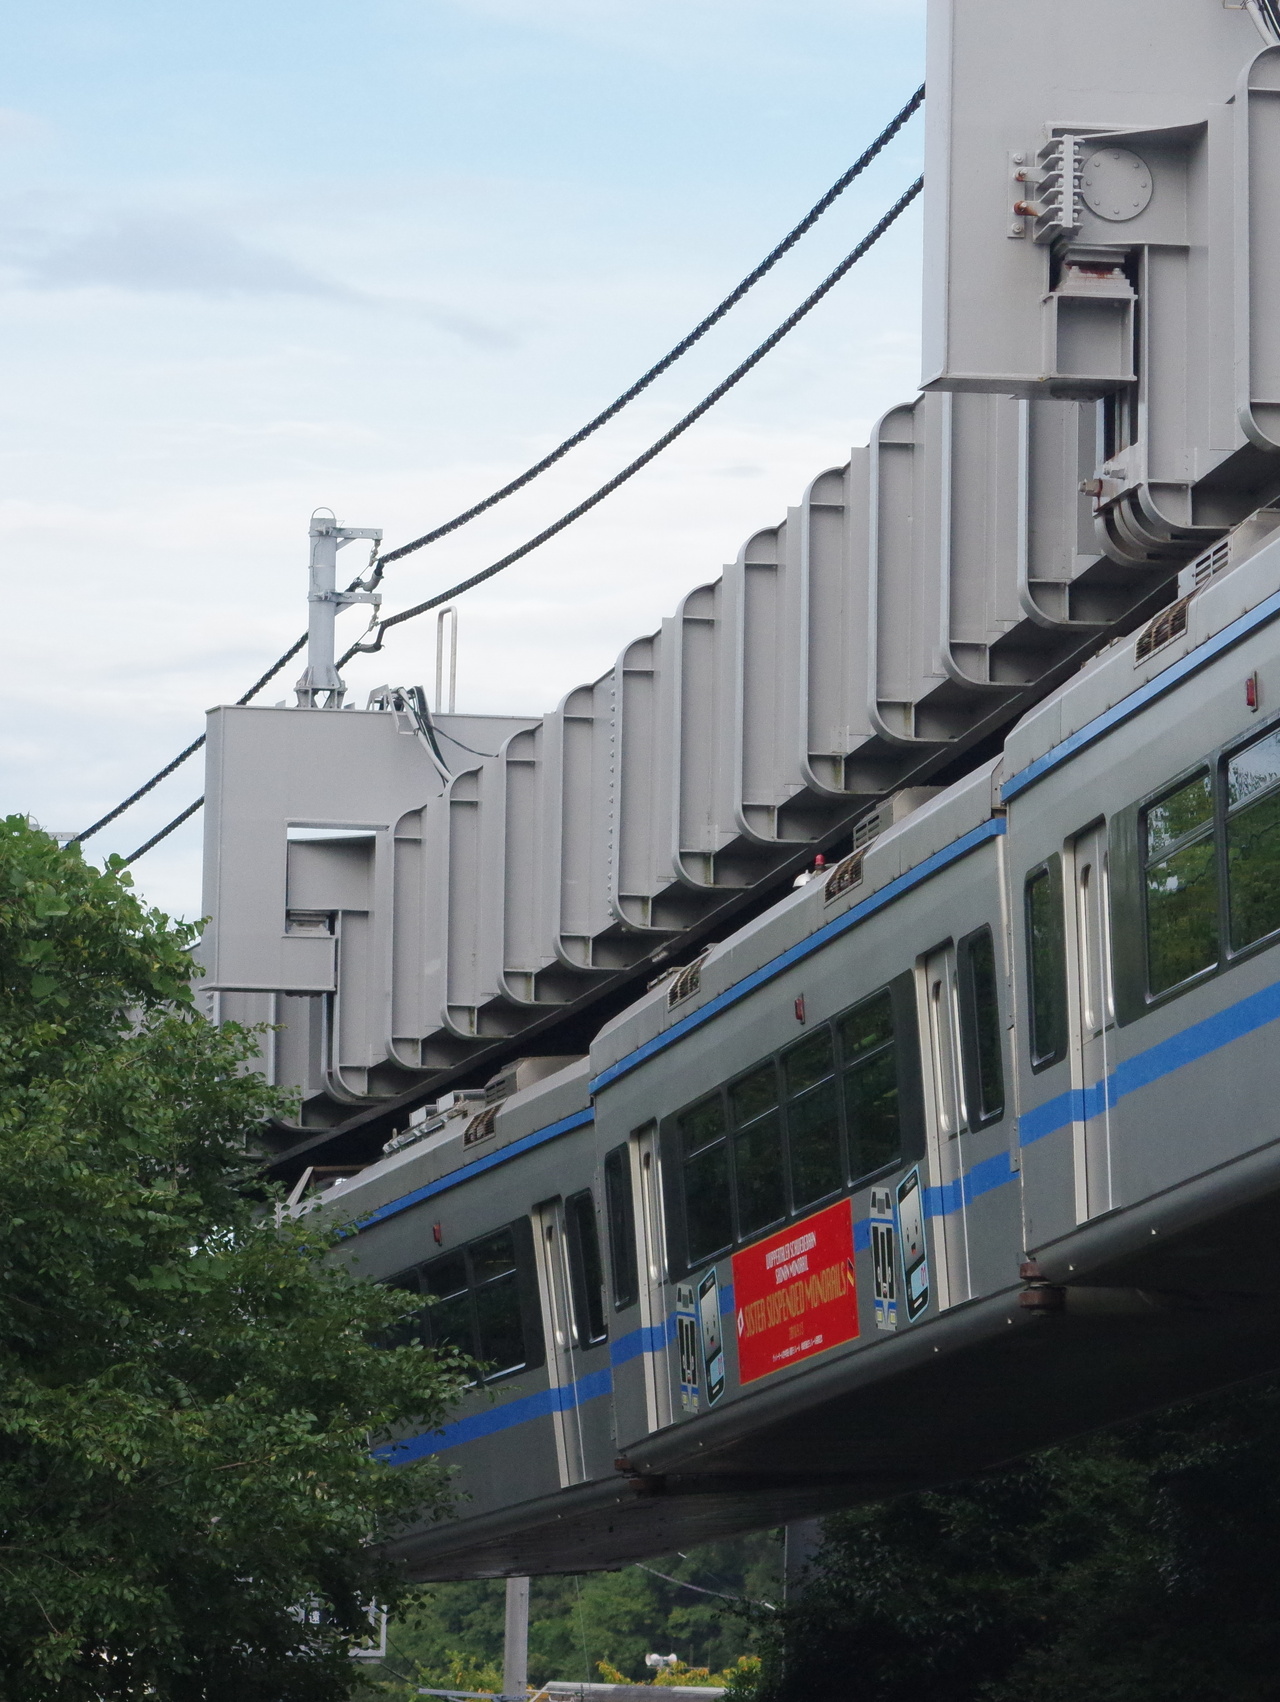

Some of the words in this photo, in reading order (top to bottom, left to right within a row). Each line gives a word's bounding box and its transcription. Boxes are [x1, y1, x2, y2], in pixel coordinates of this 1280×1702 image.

[744, 1298, 766, 1338] SISTER
[766, 1280, 805, 1328] SUSPENDED
[805, 1261, 847, 1311] MONORAILS
